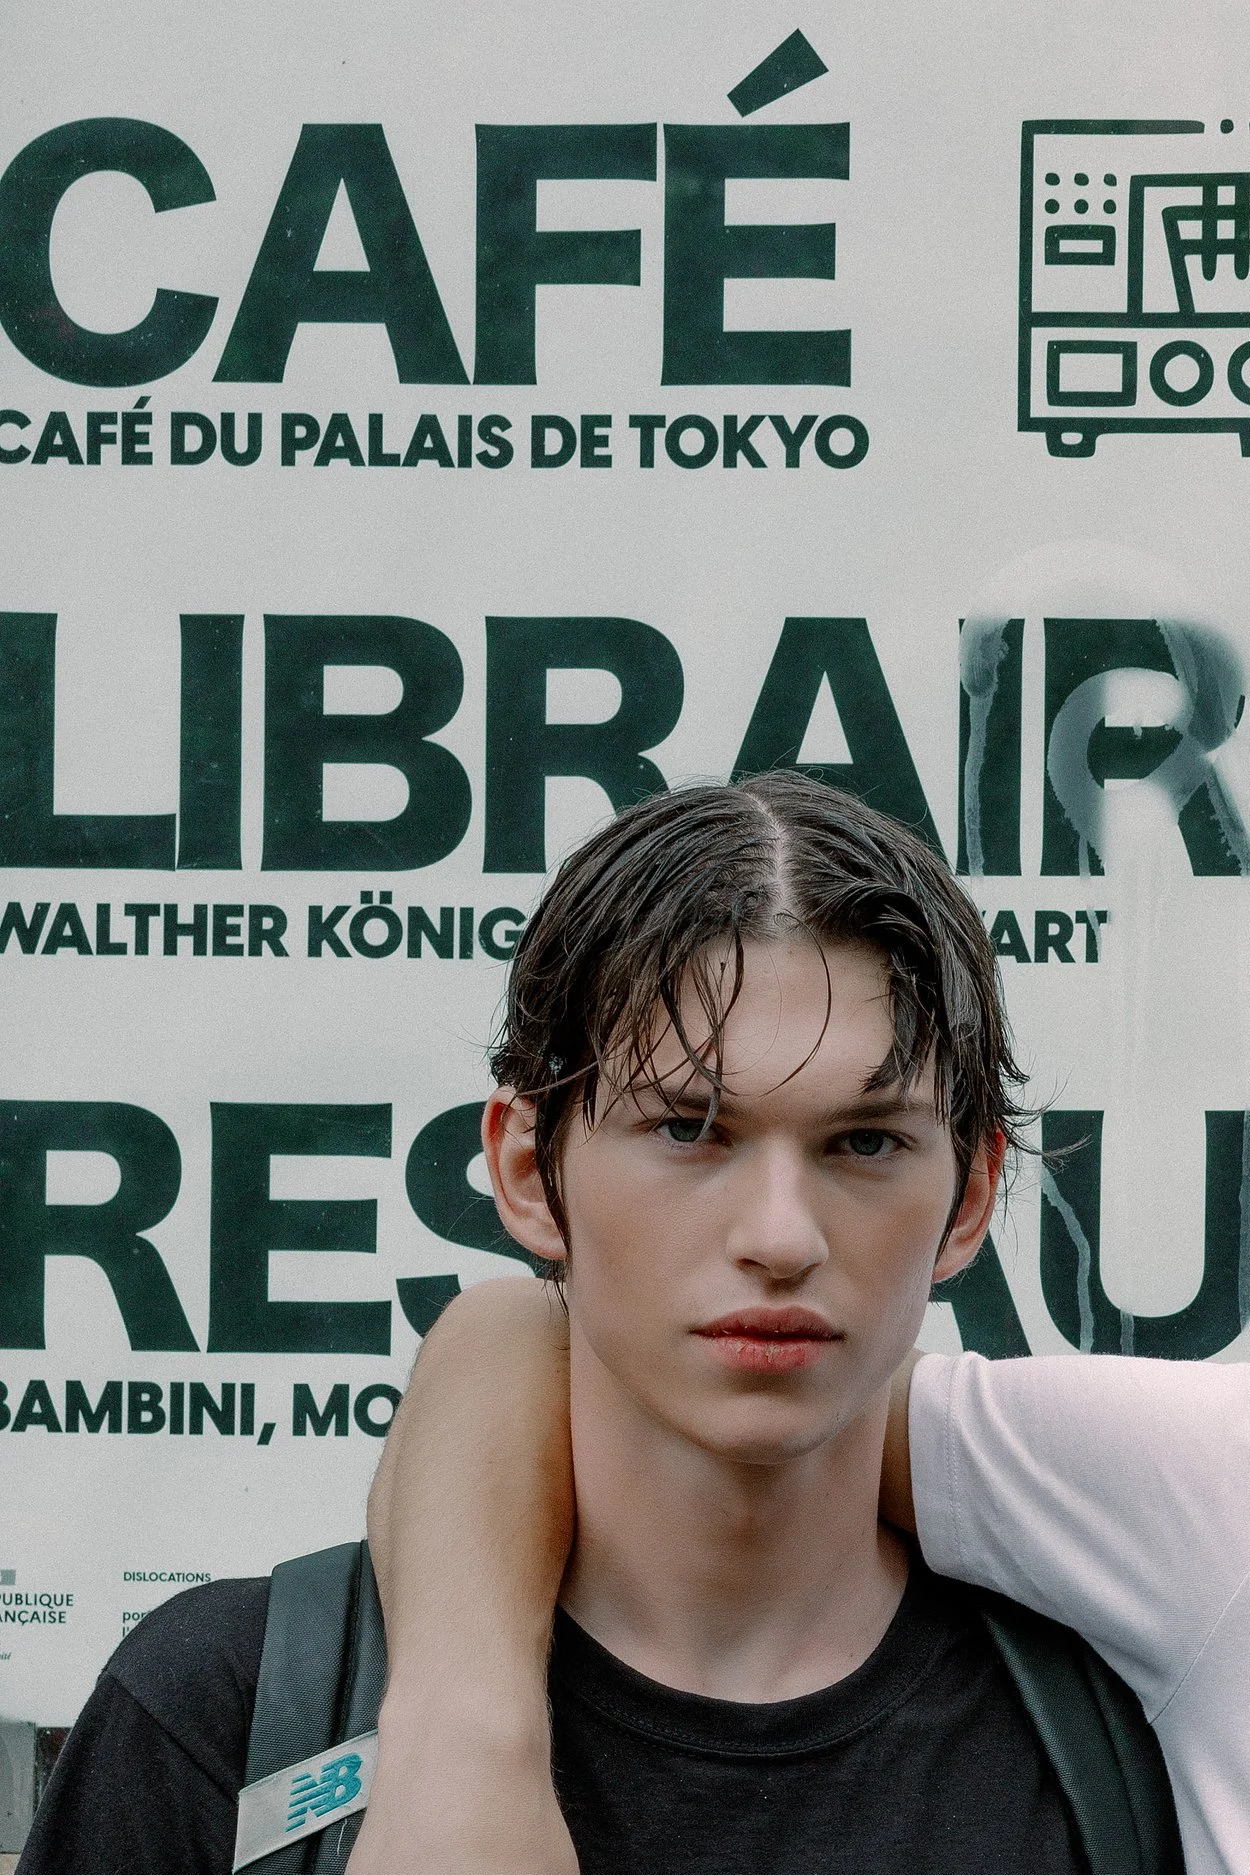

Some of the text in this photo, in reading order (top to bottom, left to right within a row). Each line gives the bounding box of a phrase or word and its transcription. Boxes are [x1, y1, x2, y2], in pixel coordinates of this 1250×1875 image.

[0, 28, 852, 389] CAFÉ
[0, 395, 870, 470] CAFÉ DU PALAIS DE TOKYO
[0, 891, 1109, 964] WALTHER KÖNIG ART
[123, 1571, 212, 1582] DISLOCATIONS
[0, 1593, 74, 1609] UBLIQUE
[0, 1610, 67, 1626] NÇAISE
